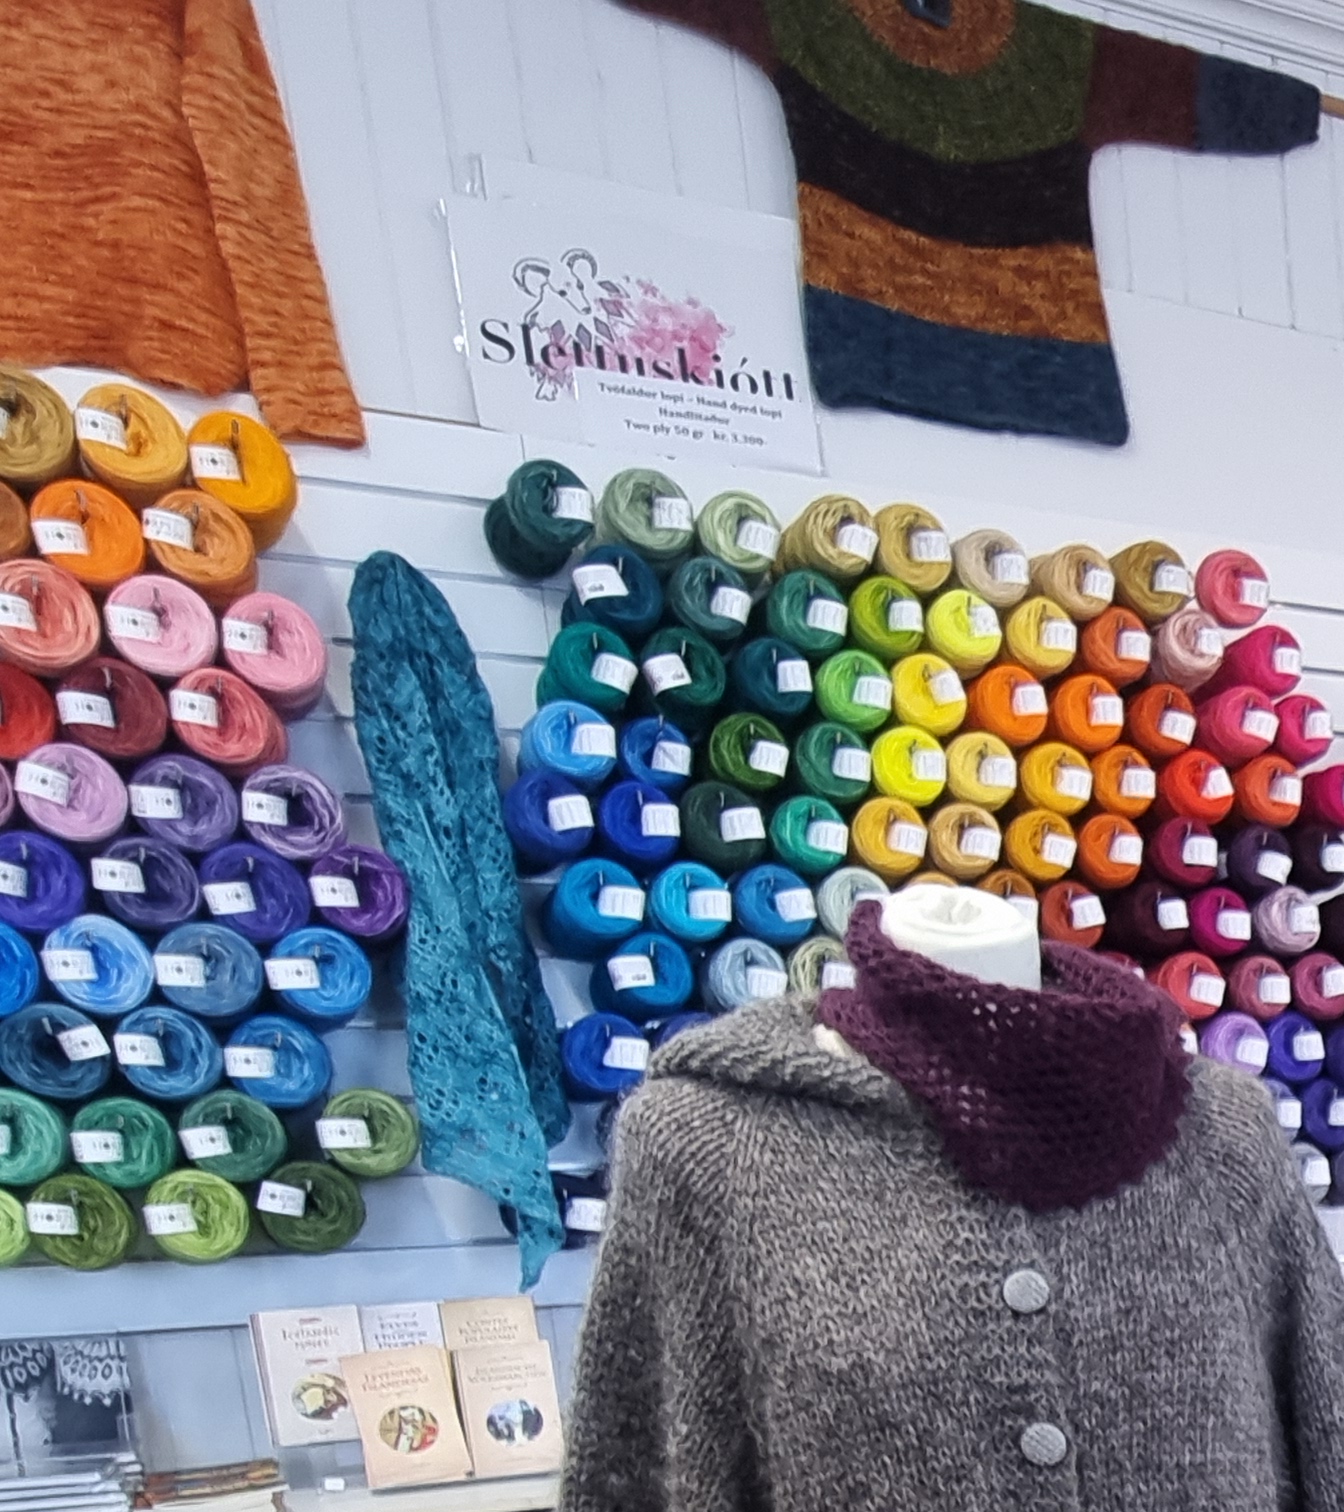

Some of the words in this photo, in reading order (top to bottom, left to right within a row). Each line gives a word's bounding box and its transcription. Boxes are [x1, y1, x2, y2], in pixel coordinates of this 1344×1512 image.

[660, 390, 685, 406] lopi
[696, 395, 727, 410] Hand
[730, 402, 757, 416] dyed
[760, 407, 782, 420] lopi
[623, 419, 650, 432] Two
[652, 424, 671, 438] ply
